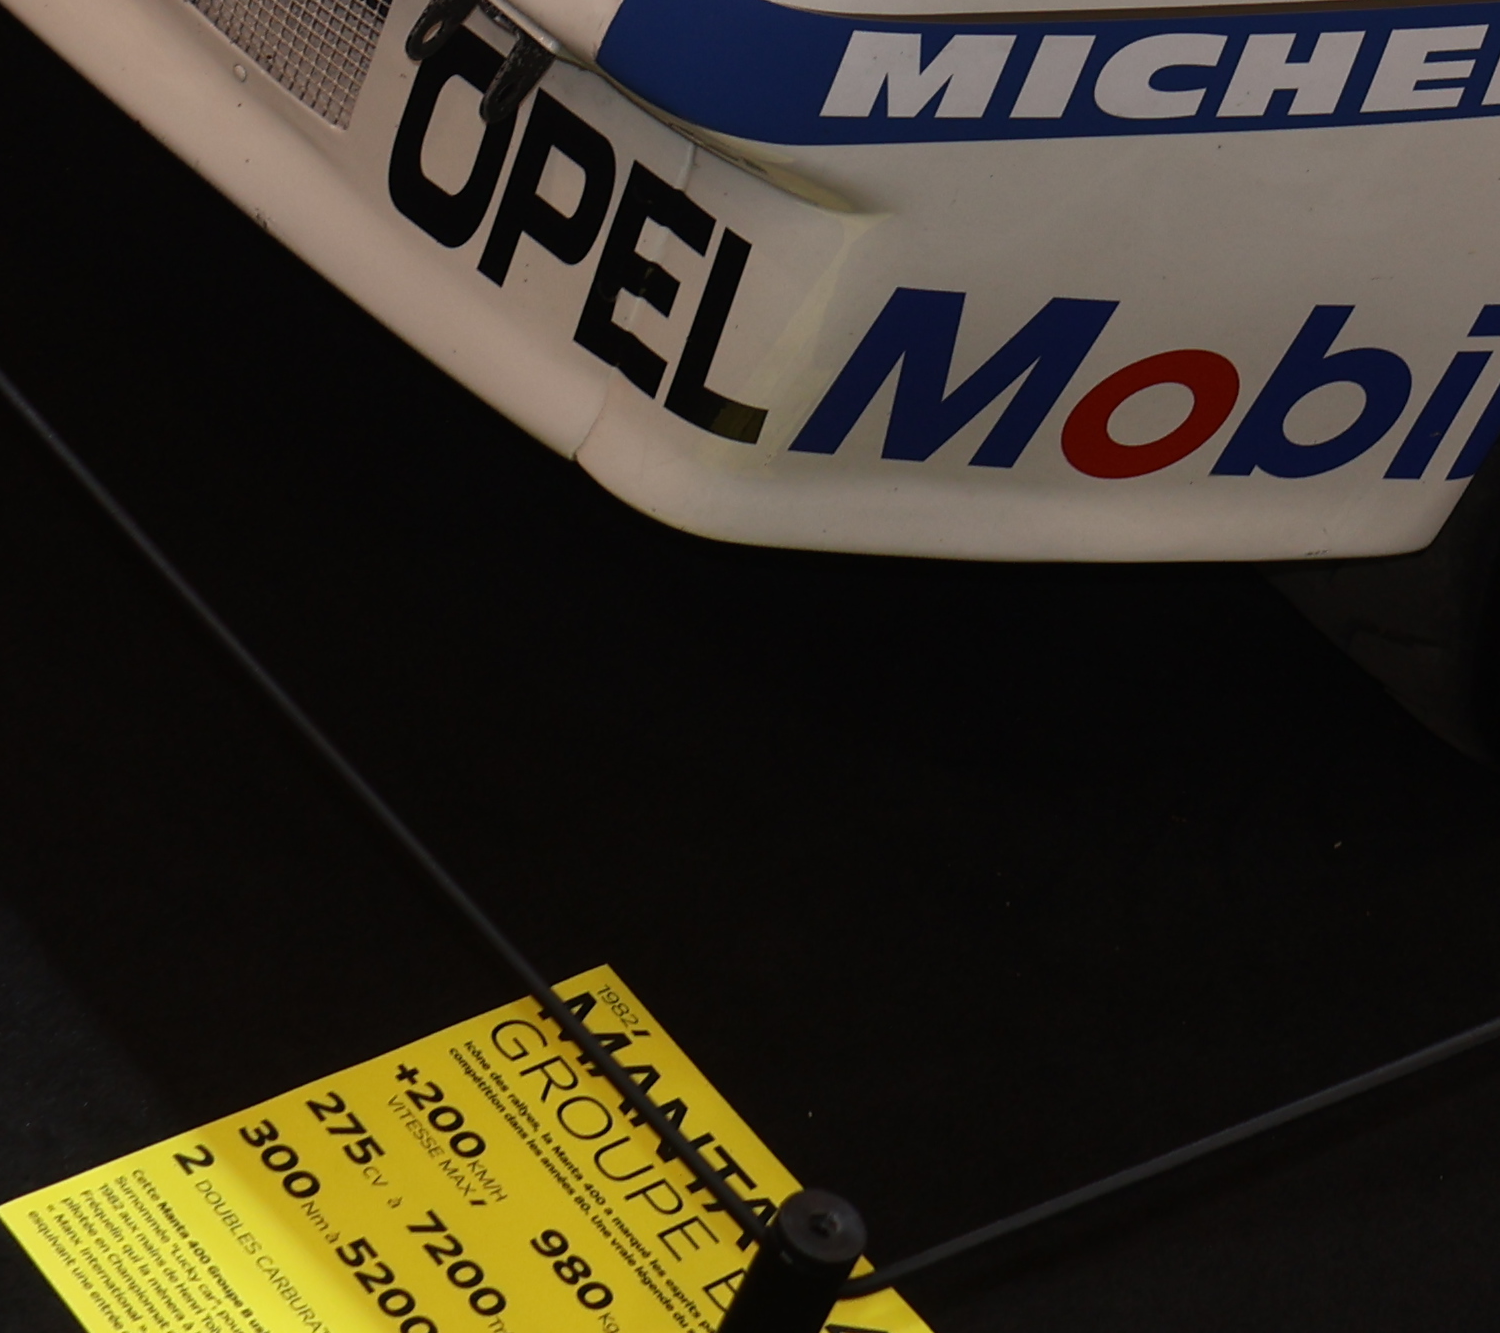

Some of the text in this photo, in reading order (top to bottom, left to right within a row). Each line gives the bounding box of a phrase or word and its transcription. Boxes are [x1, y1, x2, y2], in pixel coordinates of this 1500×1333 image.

[385, 20, 771, 445] OPEL
[239, 1119, 320, 1198] 300
[388, 1095, 444, 1157] VITESSE
[450, 1048, 506, 1112] compétition
[504, 1113, 528, 1139] dans
[527, 1139, 542, 1156] les
[541, 1158, 575, 1195] années
[591, 1215, 611, 1238] Une
[635, 1266, 674, 1311] légende
[491, 1020, 719, 1261] GROUPE
[115, 1176, 170, 1243] Surnommée
[133, 1170, 160, 1200] Cette
[158, 1202, 189, 1239] Manta
[189, 1241, 210, 1264] 400
[208, 1266, 243, 1307] Groupe
[242, 1309, 252, 1318] B
[174, 1145, 214, 1175] 2
[195, 1180, 261, 1254] DOUBLES
[306, 1092, 385, 1164] 275
[407, 1210, 506, 1316] 7200
[490, 1073, 508, 1092] des
[552, 1146, 583, 1181] Manta
[584, 1184, 605, 1205] 400
[612, 1217, 651, 1258] marqué
[666, 1280, 700, 1318] esprits
[108, 1254, 169, 1329] Championnat
[136, 1233, 166, 1267] mains
[176, 1283, 205, 1314] Henri
[531, 1230, 613, 1310] 980
